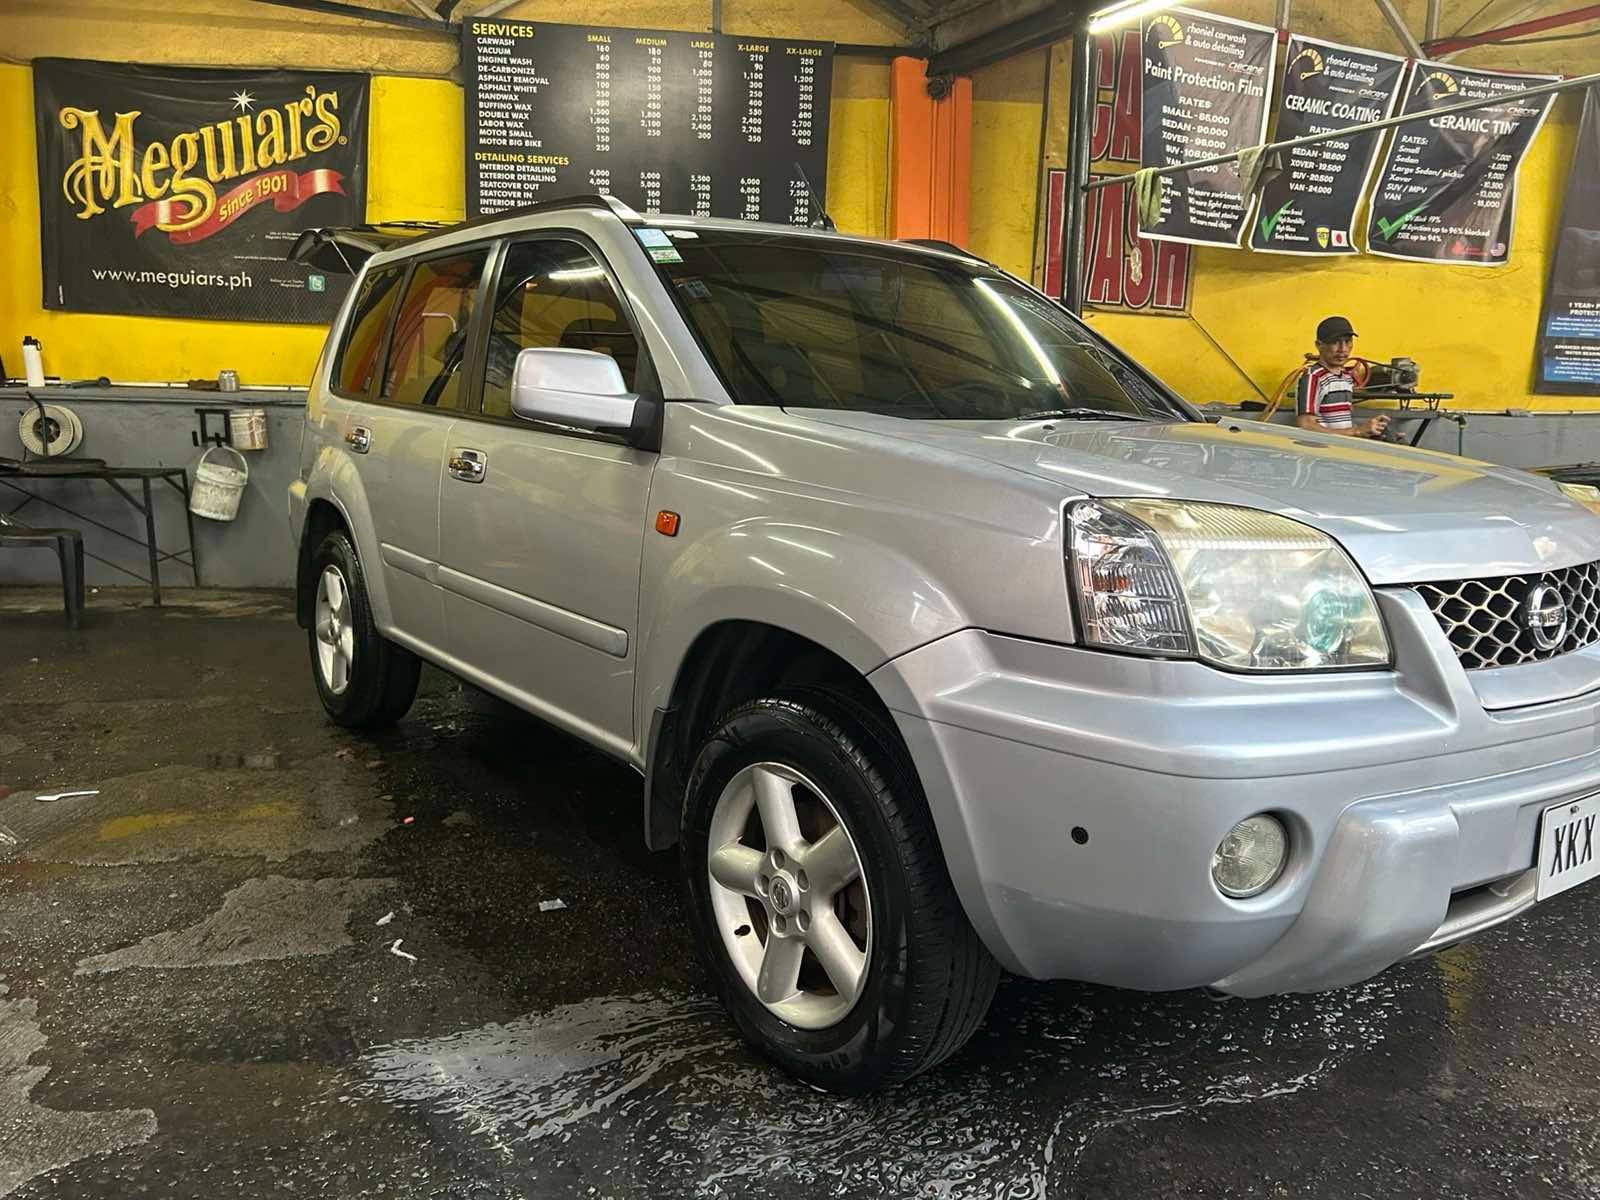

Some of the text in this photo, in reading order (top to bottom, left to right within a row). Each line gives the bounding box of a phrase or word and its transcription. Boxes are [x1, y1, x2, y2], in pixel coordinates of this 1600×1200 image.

[472, 23, 533, 37] SERVICES
[1187, 23, 1246, 44] rhoniel carwash
[477, 38, 515, 46] CARWASH
[635, 38, 666, 46] MEDIUM
[738, 44, 769, 52] X-LARGE
[1184, 36, 1244, 59] & auto detailing
[1326, 55, 1378, 72] rhoniel carwash
[478, 66, 535, 74] DE-CARBONIZE
[1323, 66, 1330, 75] &
[1330, 70, 1344, 78] auto
[514, 76, 550, 85] REMOVAL
[1145, 59, 1263, 96] Paint Protection Film
[1461, 77, 1490, 88] rhoniel
[478, 83, 511, 92] ASPHALT
[479, 92, 519, 101] HANDWAX
[1459, 88, 1466, 96] &
[1468, 89, 1486, 98] auto
[1162, 105, 1193, 118] SMALL
[1286, 95, 1380, 122] CERAMIC COATING
[1162, 118, 1191, 132] SEDAN
[1430, 116, 1489, 132] CERAMIC
[1162, 130, 1189, 144] XOVER
[1402, 136, 1428, 144] RATES:
[1166, 145, 1179, 154] SUV
[1292, 148, 1318, 157] SEDAN
[1399, 145, 1420, 154] Small
[59, 85, 343, 232] Meguiar's
[475, 153, 569, 165] DETAILING SERVICES
[1290, 159, 1314, 168] XOVER
[1395, 155, 1418, 164] Sedan
[1392, 165, 1414, 175] Large
[1389, 175, 1412, 183] Xover
[480, 181, 521, 190] SEATCOVER
[1289, 183, 1306, 191] VAN
[1387, 183, 1402, 192] SUV
[218, 174, 288, 222] since 1901
[480, 190, 521, 198] SEATCOVER
[1384, 192, 1401, 200] VAN
[93, 268, 252, 288] www.meguiars.ph
[1550, 813, 1596, 877] XKX
